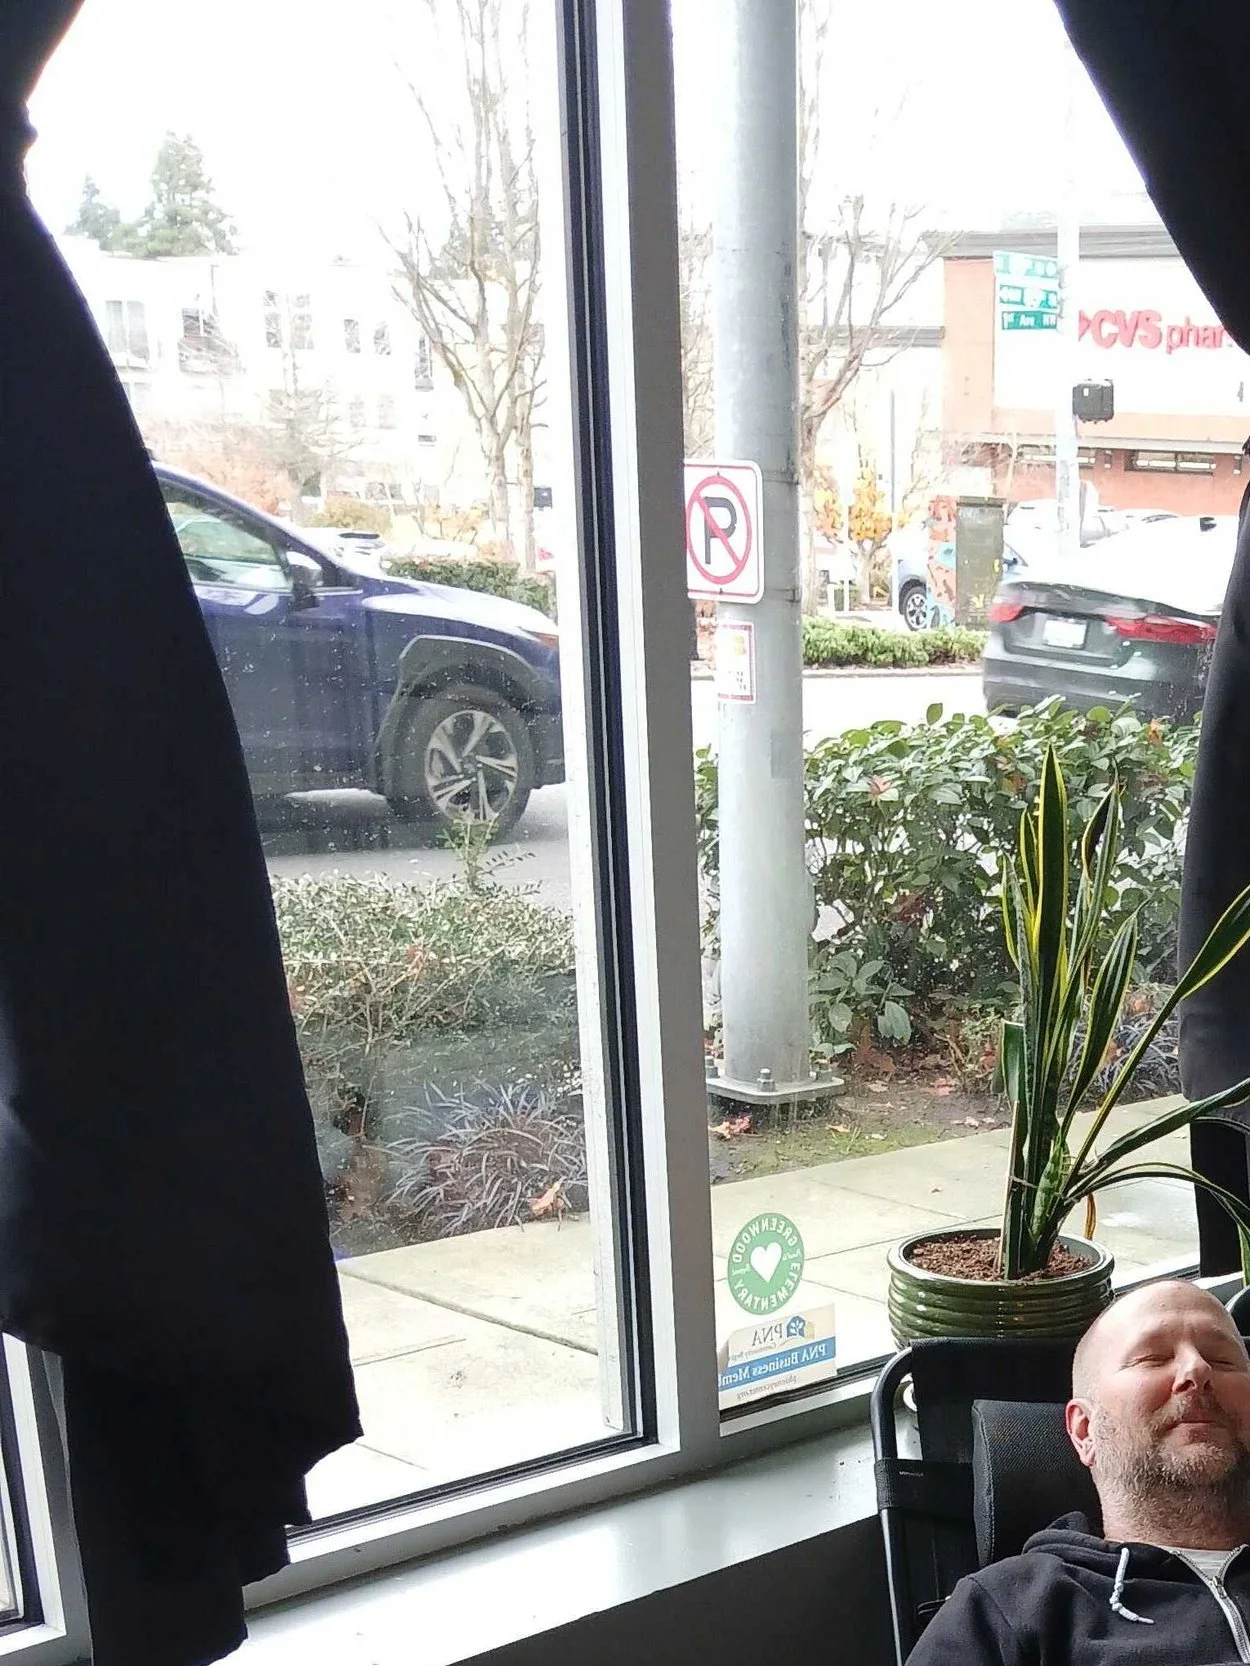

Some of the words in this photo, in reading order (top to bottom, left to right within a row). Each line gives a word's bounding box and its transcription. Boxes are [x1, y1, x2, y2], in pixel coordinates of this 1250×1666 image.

[1091, 310, 1163, 349] CVS
[1167, 316, 1232, 354] phar
[703, 496, 737, 565] P
